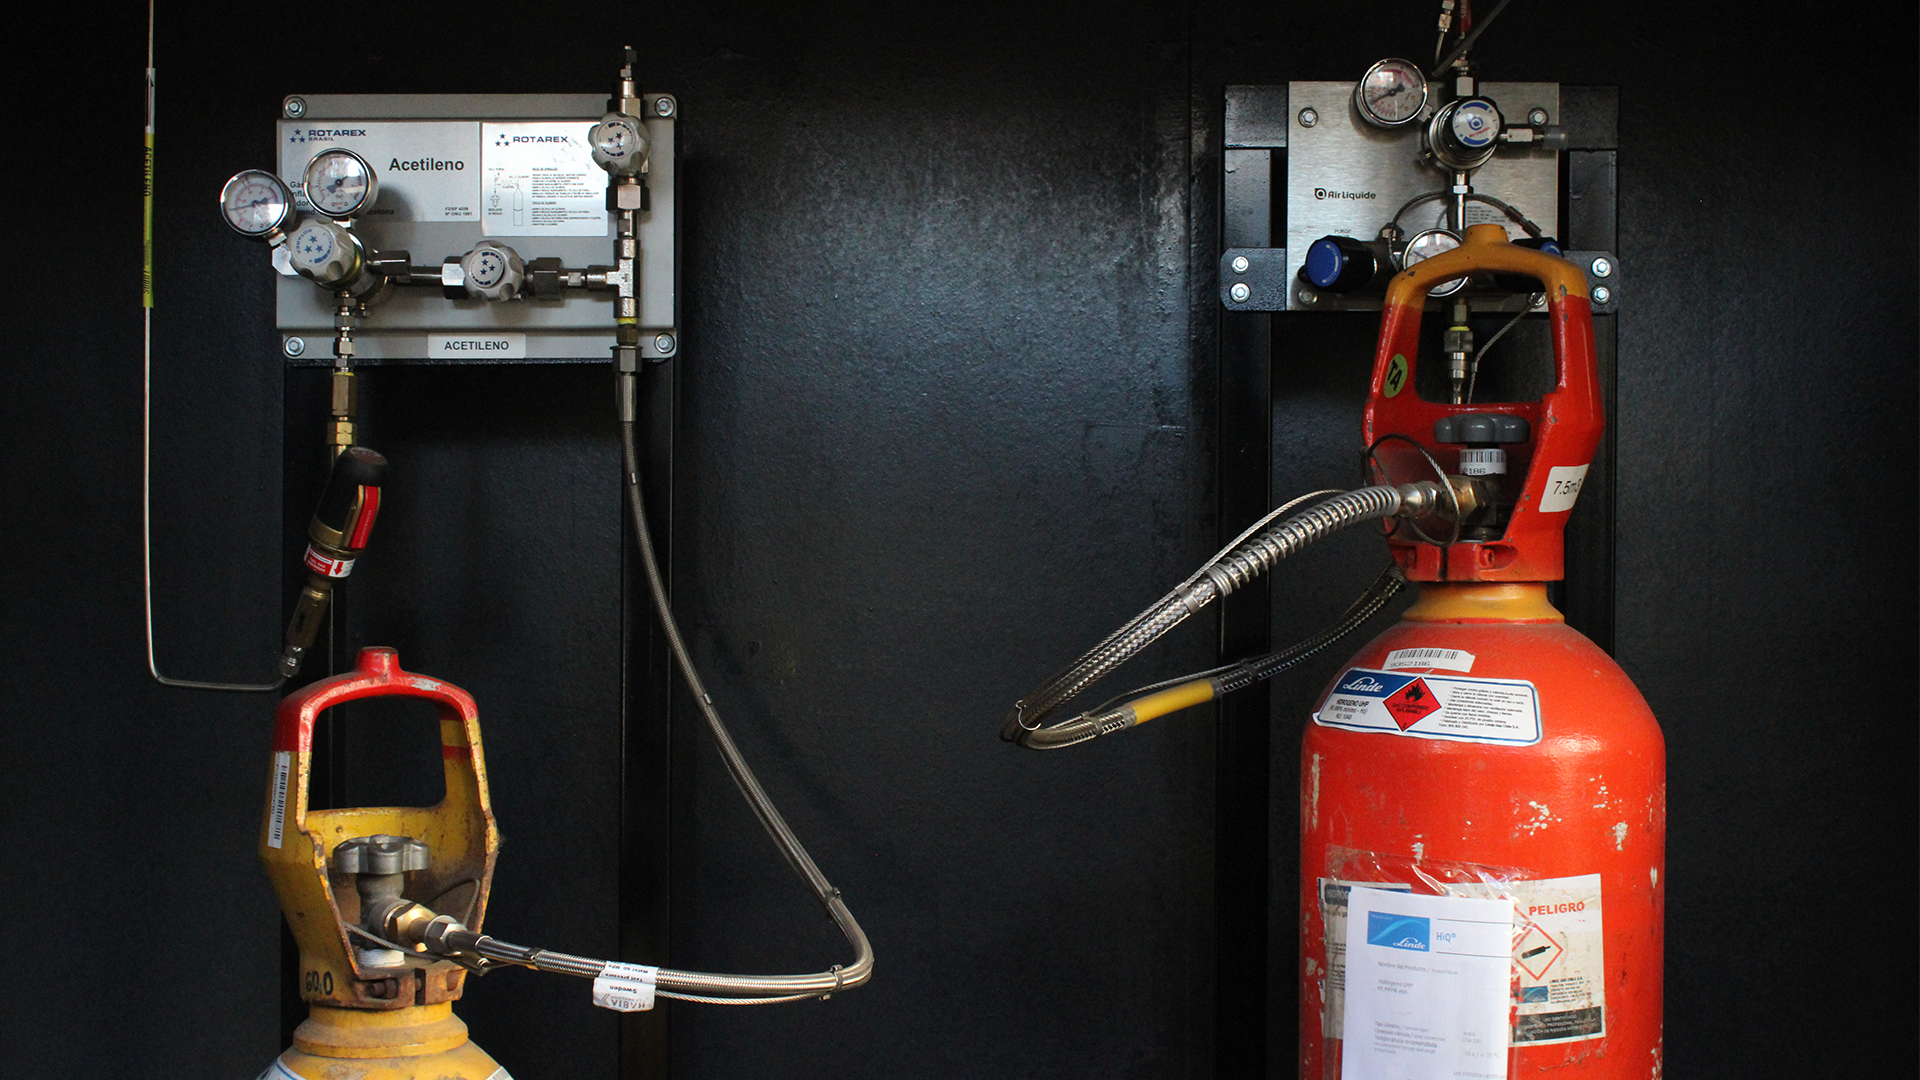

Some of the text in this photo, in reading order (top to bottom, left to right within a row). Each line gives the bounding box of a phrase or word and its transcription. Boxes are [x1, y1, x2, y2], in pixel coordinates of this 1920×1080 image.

[308, 129, 366, 137] ROTAREX
[389, 158, 465, 171] Acetileno
[1342, 191, 1376, 200] Liquide
[444, 341, 509, 350] ACETILENO
[1387, 359, 1403, 391] TA
[1343, 677, 1383, 692] Linde
[1529, 901, 1585, 916] PELIGRO
[1393, 937, 1426, 949] Linde
[1404, 964, 1427, 973] Producto
[610, 985, 637, 993] Sweden
[611, 999, 645, 1009] HABIA
